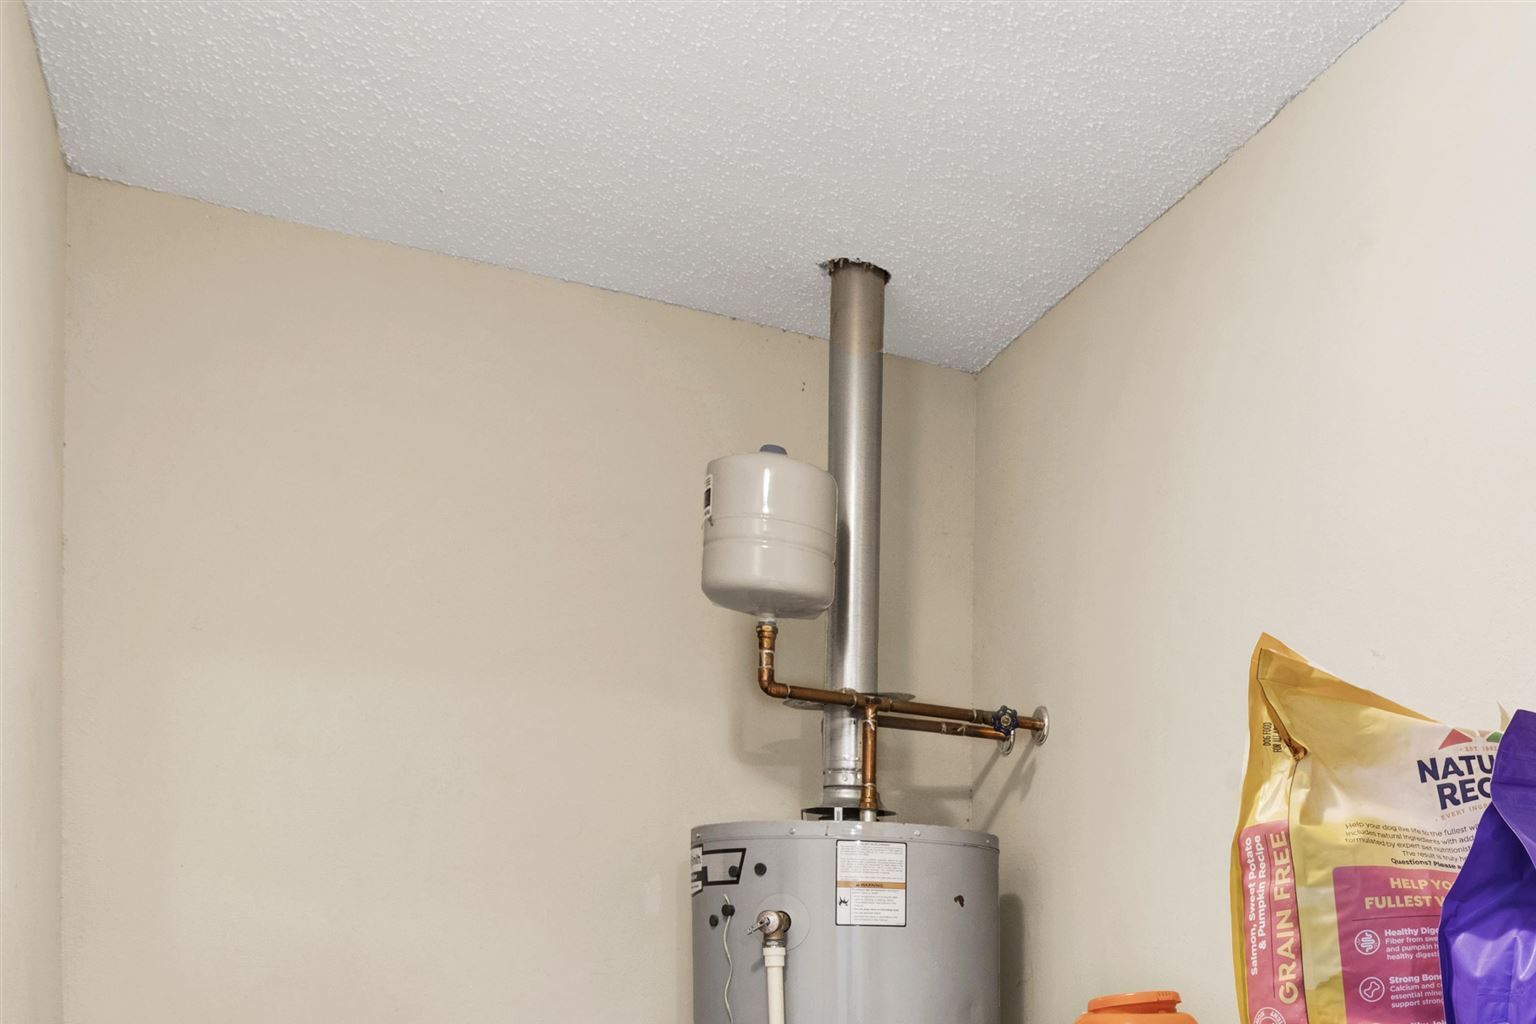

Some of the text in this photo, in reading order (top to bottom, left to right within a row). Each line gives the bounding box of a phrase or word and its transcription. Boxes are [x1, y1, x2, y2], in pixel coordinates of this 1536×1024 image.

[1417, 755, 1494, 783] NATU
[1437, 777, 1491, 810] REC
[1245, 837, 1256, 881] Potato
[1255, 835, 1266, 878] Recipe
[1391, 858, 1432, 866] Questions?
[1390, 877, 1451, 890] HELP YO
[1257, 881, 1267, 936] Pumpkin
[1365, 895, 1432, 909] FULLEST
[1270, 831, 1299, 1005] GRAIN FREE
[1384, 927, 1419, 937] Healthy
[1385, 937, 1405, 945] Fiber
[1401, 943, 1433, 953] pumpkin
[1387, 953, 1413, 961] healthy
[1389, 975, 1420, 984] Strong
[1389, 984, 1420, 992] Calcium
